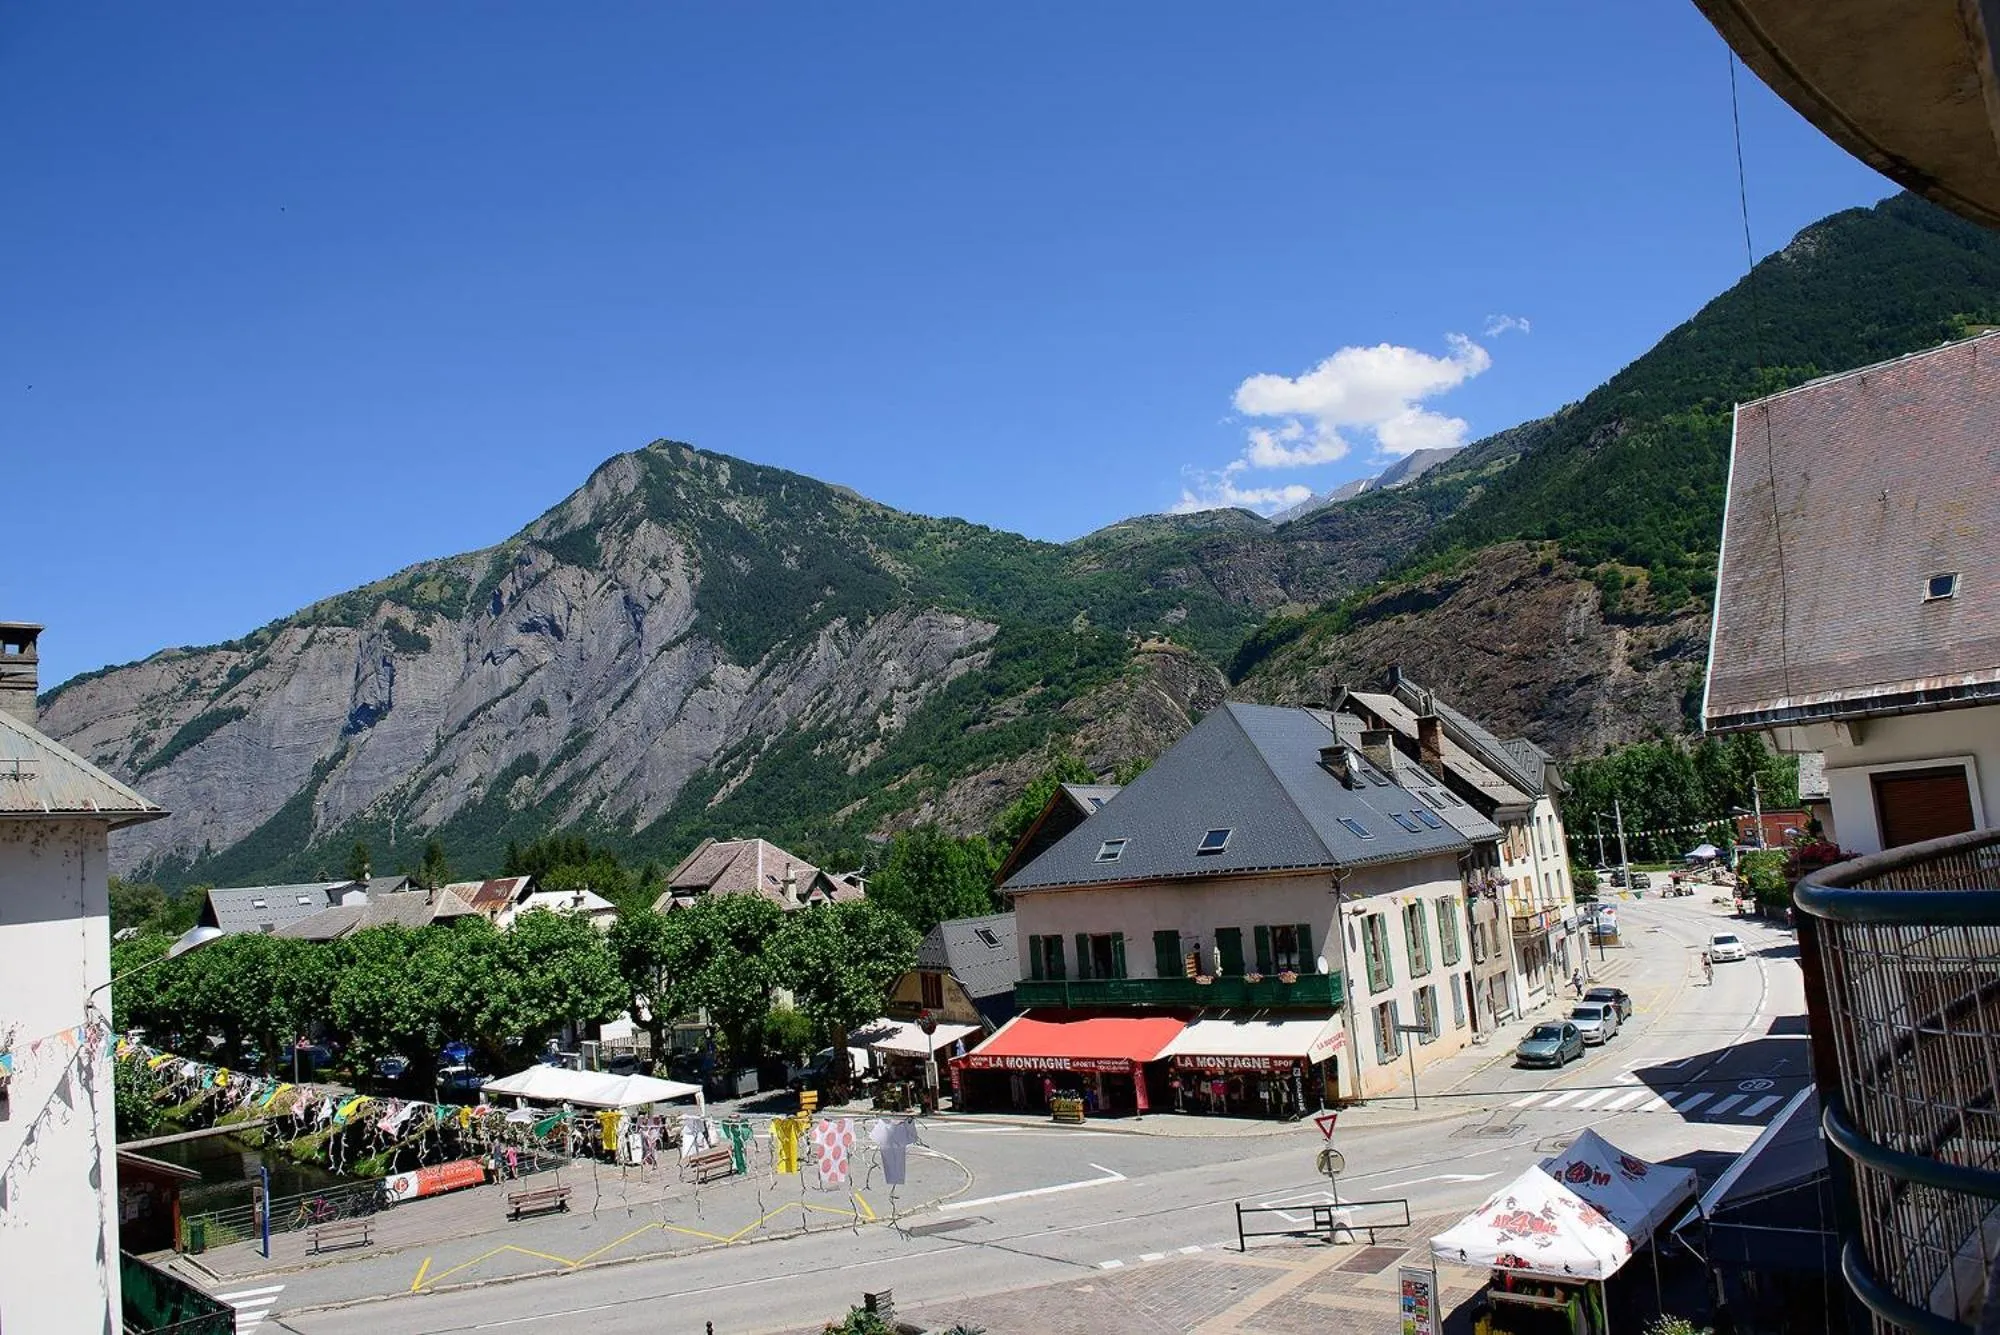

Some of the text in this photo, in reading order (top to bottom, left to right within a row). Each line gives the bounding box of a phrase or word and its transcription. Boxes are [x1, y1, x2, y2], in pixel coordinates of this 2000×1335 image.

[989, 1056, 1003, 1068] LA
[1006, 1056, 1071, 1070] MONTAGNE
[1177, 1056, 1193, 1068] LA
[1196, 1056, 1270, 1068] MONTAGNE
